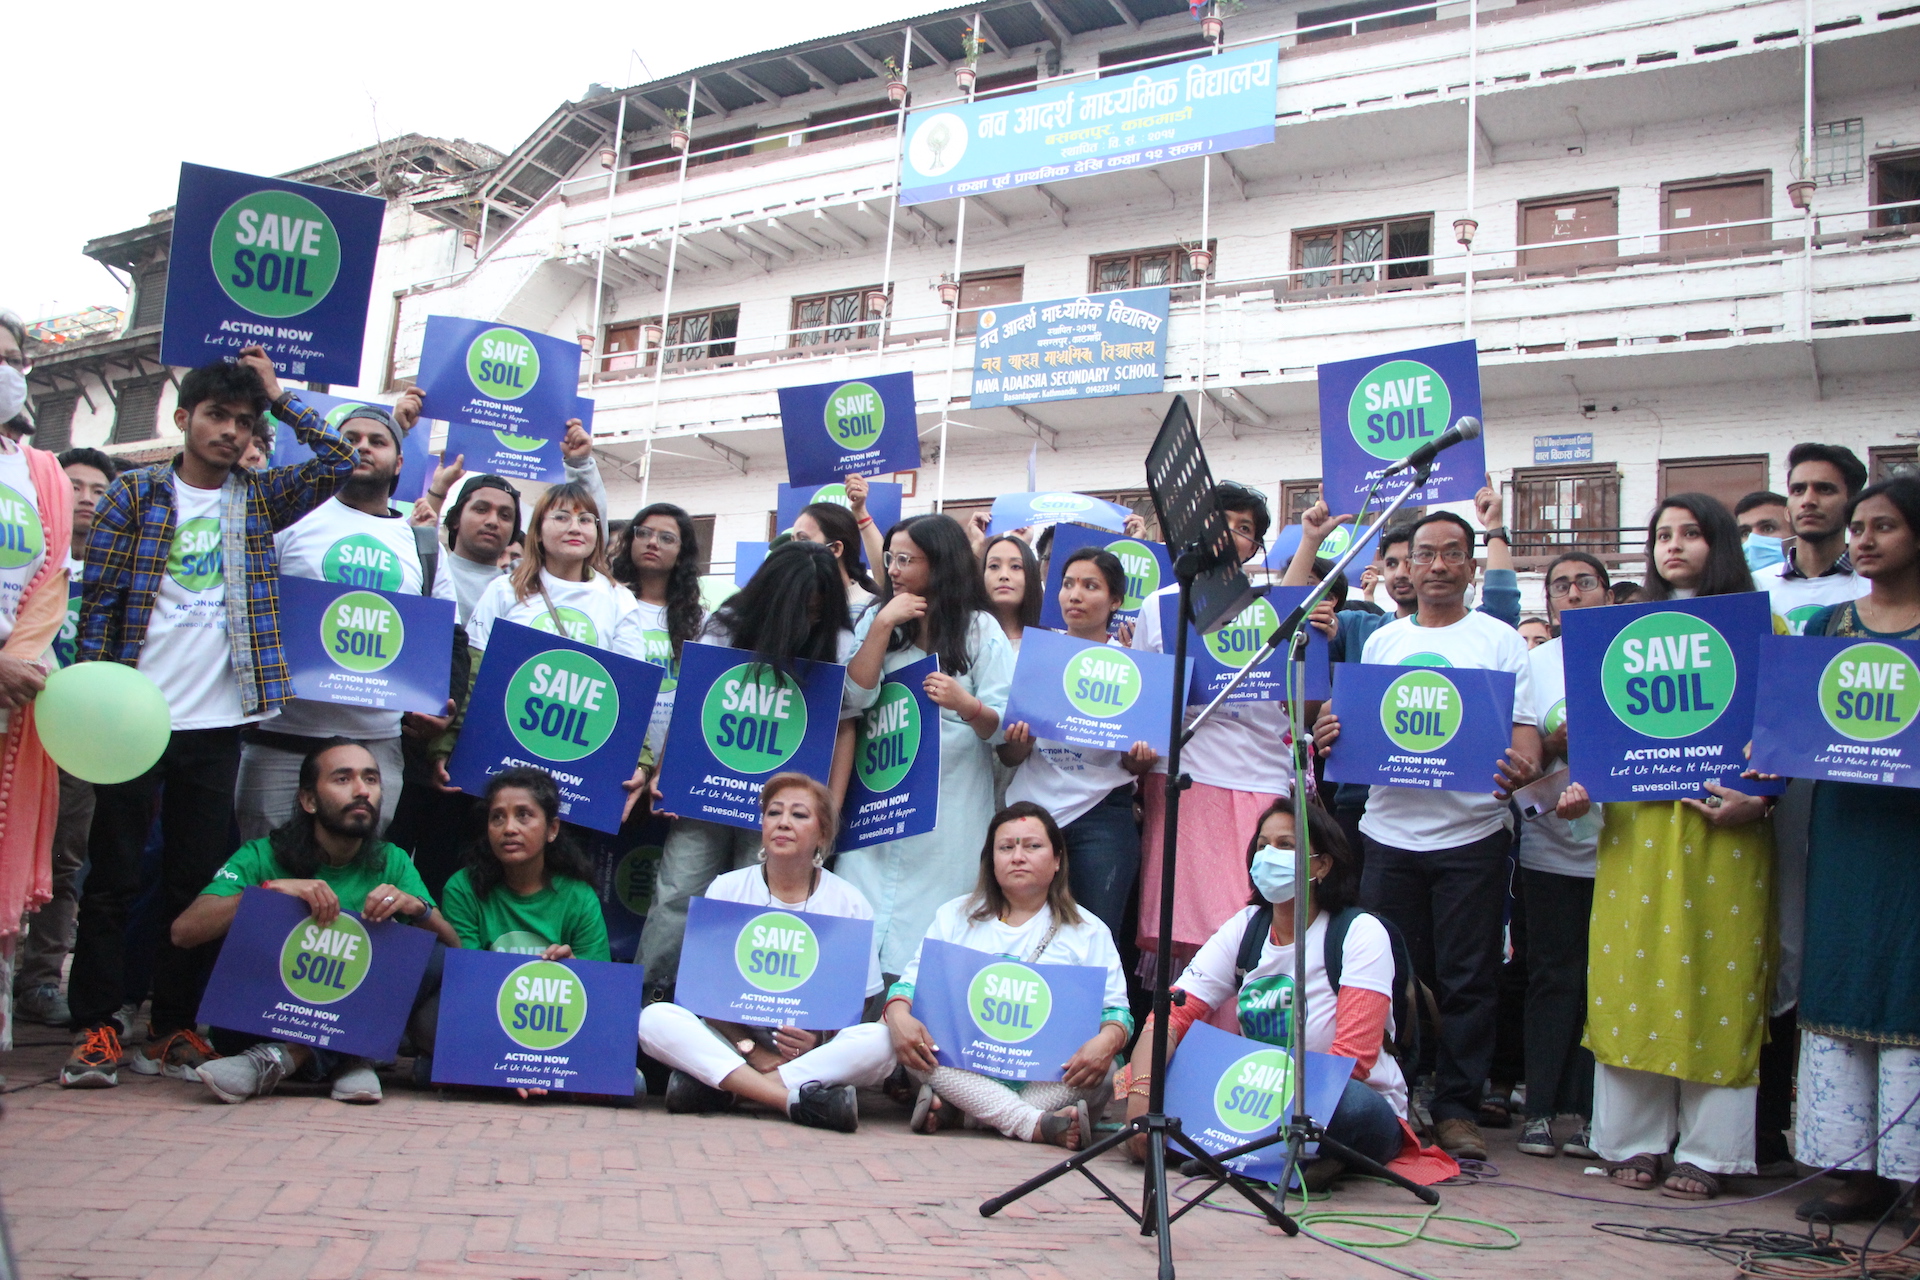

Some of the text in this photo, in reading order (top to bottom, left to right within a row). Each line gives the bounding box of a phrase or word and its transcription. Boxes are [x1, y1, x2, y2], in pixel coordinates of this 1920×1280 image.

[978, 58, 1273, 141] नव आदर्श माध्यमिक विद्यालय
[235, 209, 323, 256] SAVE
[232, 249, 313, 297] SOIL
[220, 320, 313, 342] ACTION NOW
[979, 296, 1163, 350] नव आदर्श माध्यमिक विद्यालय
[204, 334, 225, 346] Let
[228, 337, 242, 347] Us
[277, 343, 286, 353] It
[289, 345, 325, 359] Happen
[481, 338, 529, 367] SAVE
[479, 361, 524, 389] SOIL
[975, 363, 1159, 394] NAVA ADARSHA SECONDARY SCHOOL
[835, 393, 875, 417] SAVE
[1365, 375, 1432, 411] SAVE
[471, 398, 523, 414] ACTION NOW
[471, 418, 507, 430] savesoil.org
[838, 414, 876, 439] SOIL
[1367, 408, 1434, 444] SOIL
[495, 451, 542, 463] ACTION NOW
[840, 450, 881, 463] ACTION NOW
[496, 468, 528, 479] savesoil.org
[339, 544, 391, 572] SAVE
[337, 604, 391, 633] SAVE
[335, 629, 387, 659] SOIL
[1217, 628, 1262, 653] SOIL
[1623, 633, 1711, 674] SAVE
[329, 673, 389, 686] ACTION NOW
[1079, 657, 1130, 684] SAVE
[1838, 661, 1906, 690] SAVE
[331, 694, 373, 705] savesoil.org
[529, 663, 607, 712] SAVE
[722, 680, 793, 719] SAVE
[1075, 677, 1123, 706] SOIL
[1396, 685, 1449, 710] SAVE
[1626, 673, 1714, 716] SOIL
[866, 697, 909, 740] SAVE
[1836, 691, 1900, 722] SOIL
[519, 697, 590, 747] SOIL
[716, 713, 783, 756] SOIL
[1065, 716, 1122, 730] ACTION NOW
[1394, 710, 1445, 737] SOIL
[1065, 735, 1104, 746] savesoil.org
[1624, 745, 1723, 761] ACTION NOW
[1826, 744, 1901, 757] ACTION NOW
[865, 732, 908, 775] SOIL
[1388, 755, 1447, 766] ACTION NOW
[1814, 754, 1911, 770] Let Us Make It Happen
[551, 771, 584, 786] NOW
[1378, 764, 1392, 772] Let
[1403, 766, 1421, 774] Make
[1431, 768, 1454, 776] Happen
[1389, 777, 1430, 786] savesoil.org
[1610, 762, 1740, 777] Let Us Make It Happen
[1827, 769, 1878, 781] savesoil.org
[1631, 780, 1700, 792] savesoil.org
[702, 804, 755, 822] savesoil.org
[859, 792, 909, 815] ACTION NOW
[859, 826, 894, 841] savesoil.org
[301, 925, 361, 960] SAVE
[751, 925, 806, 953] SAVE
[292, 952, 346, 989] SOIL
[748, 950, 800, 978] SOIL
[514, 975, 572, 1004] SAVE
[740, 993, 801, 1006] ACTION NOW
[984, 973, 1039, 1004] SAVE
[1247, 986, 1292, 1010] SAVE
[275, 1002, 340, 1022] ACTION NOW
[512, 1003, 568, 1033] SOIL
[741, 1013, 783, 1025] savesoil.org
[981, 997, 1033, 1029] SOIL
[1244, 1010, 1288, 1037] SOIL
[272, 1026, 317, 1043] savesoil.org
[505, 1052, 569, 1065] ACTION NOW
[972, 1040, 1032, 1057] ACTION NOW
[494, 1062, 508, 1071] Let
[522, 1064, 541, 1073] Make
[552, 1066, 578, 1076] Happen
[506, 1076, 551, 1086] savesoil.org
[972, 1062, 1014, 1076] savesoil.org
[1238, 1062, 1291, 1092] SAVE
[1224, 1086, 1274, 1120] SOIL
[1203, 1127, 1237, 1144] ACTION
